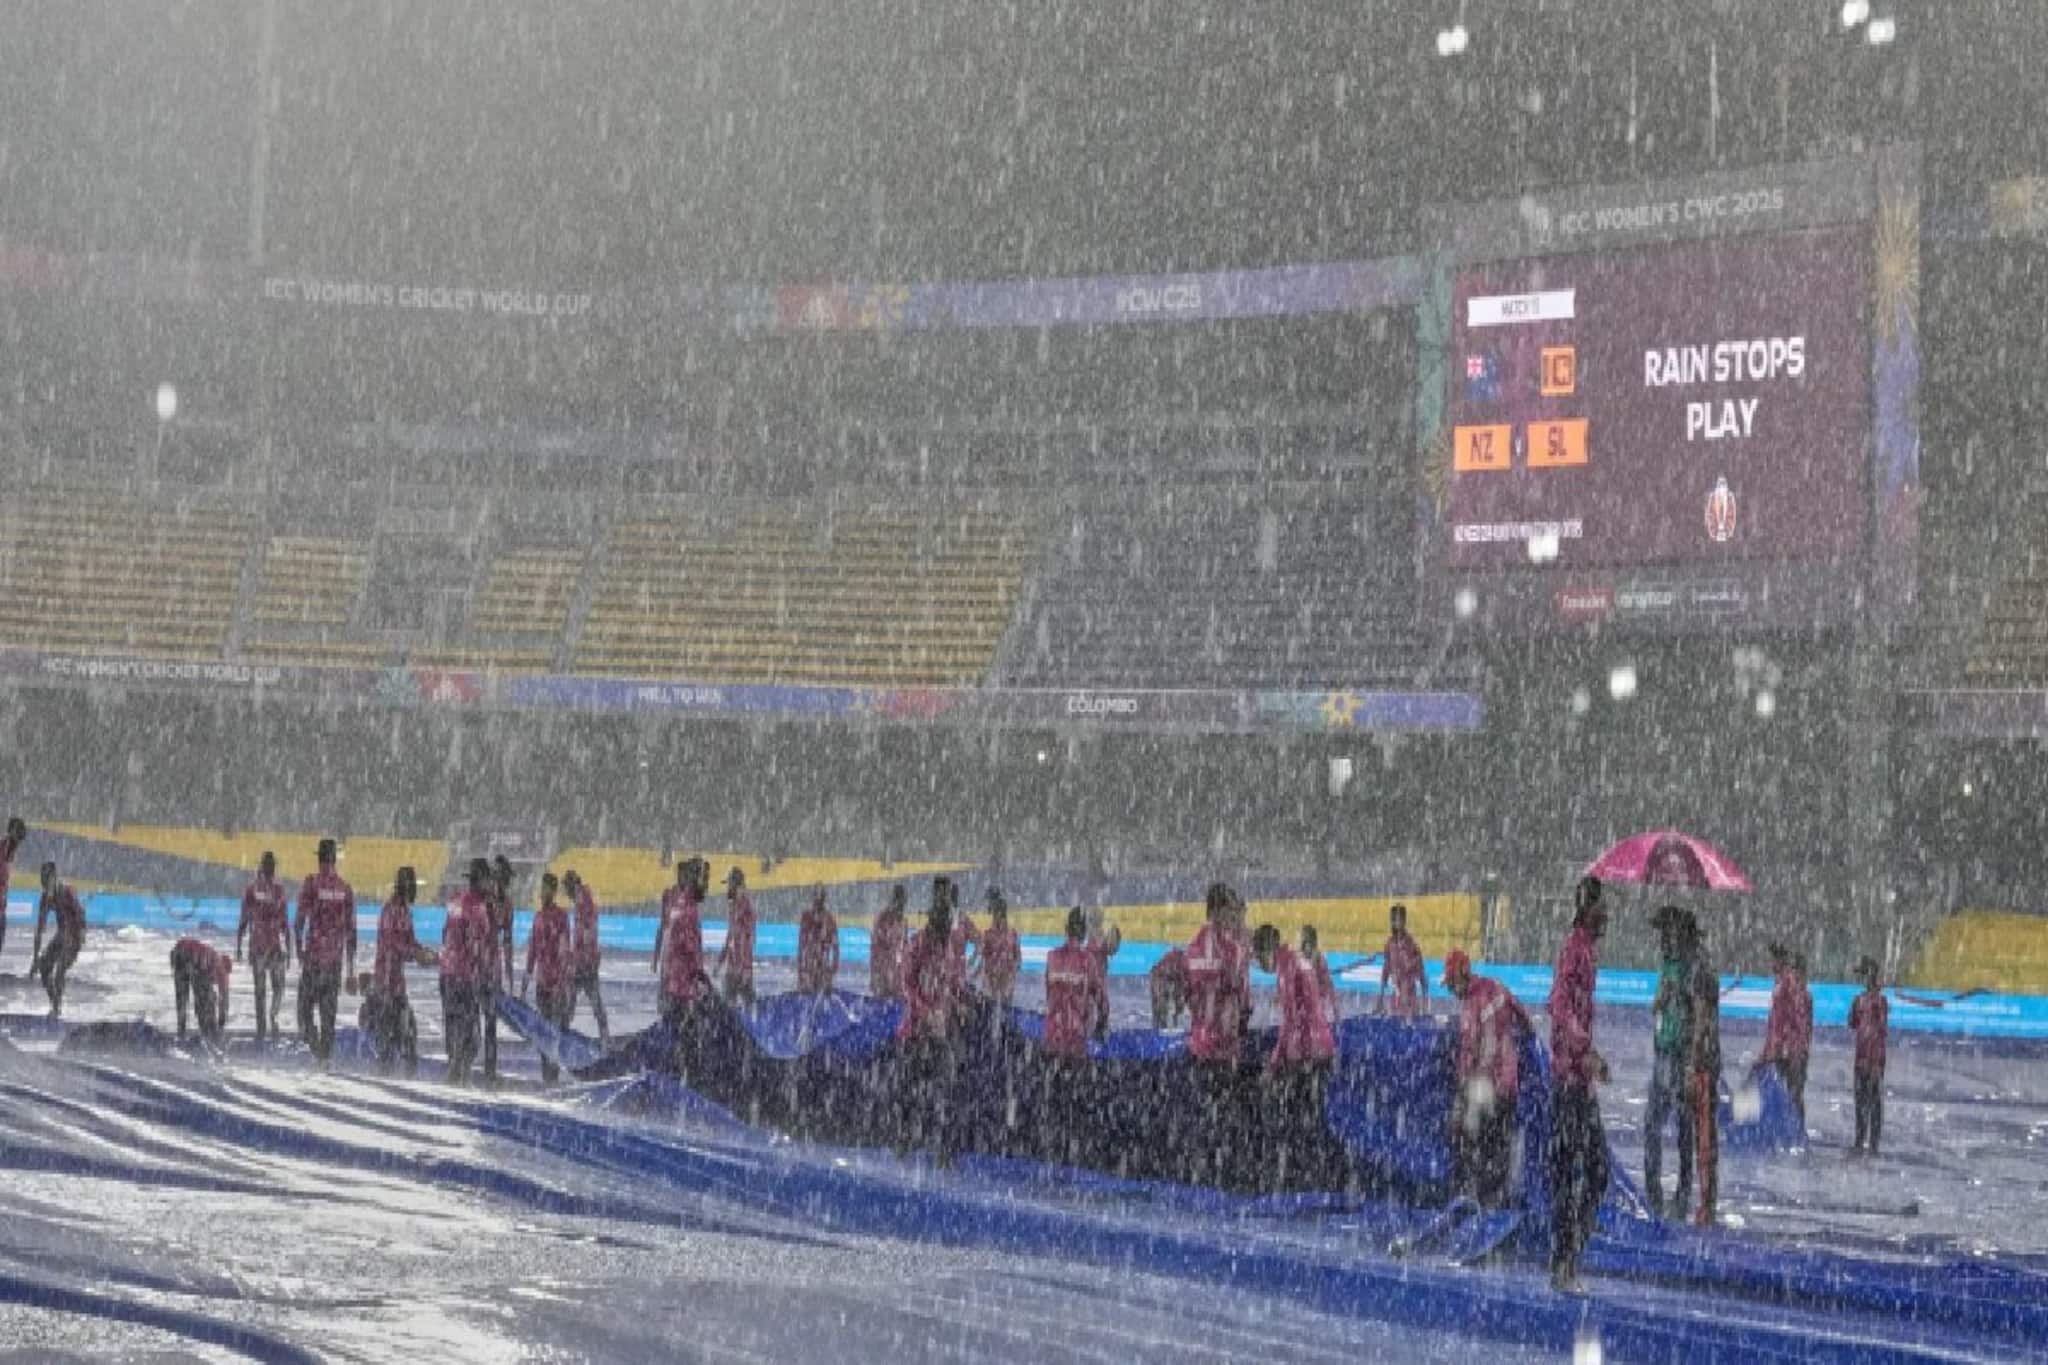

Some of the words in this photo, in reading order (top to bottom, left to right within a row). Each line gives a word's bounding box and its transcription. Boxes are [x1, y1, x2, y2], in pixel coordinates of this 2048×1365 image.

[1684, 194, 1729, 221] CWC
[1732, 188, 1784, 216] 2025
[265, 277, 296, 299] ICC
[399, 286, 474, 311] CRICKET
[480, 288, 547, 315] WORLD
[555, 293, 591, 315] CUP
[1645, 344, 1709, 387] RAIN
[1714, 336, 1805, 382] STOPS
[1687, 399, 1758, 441] PLAY
[1470, 430, 1494, 463] NZ
[1547, 425, 1567, 457] SL
